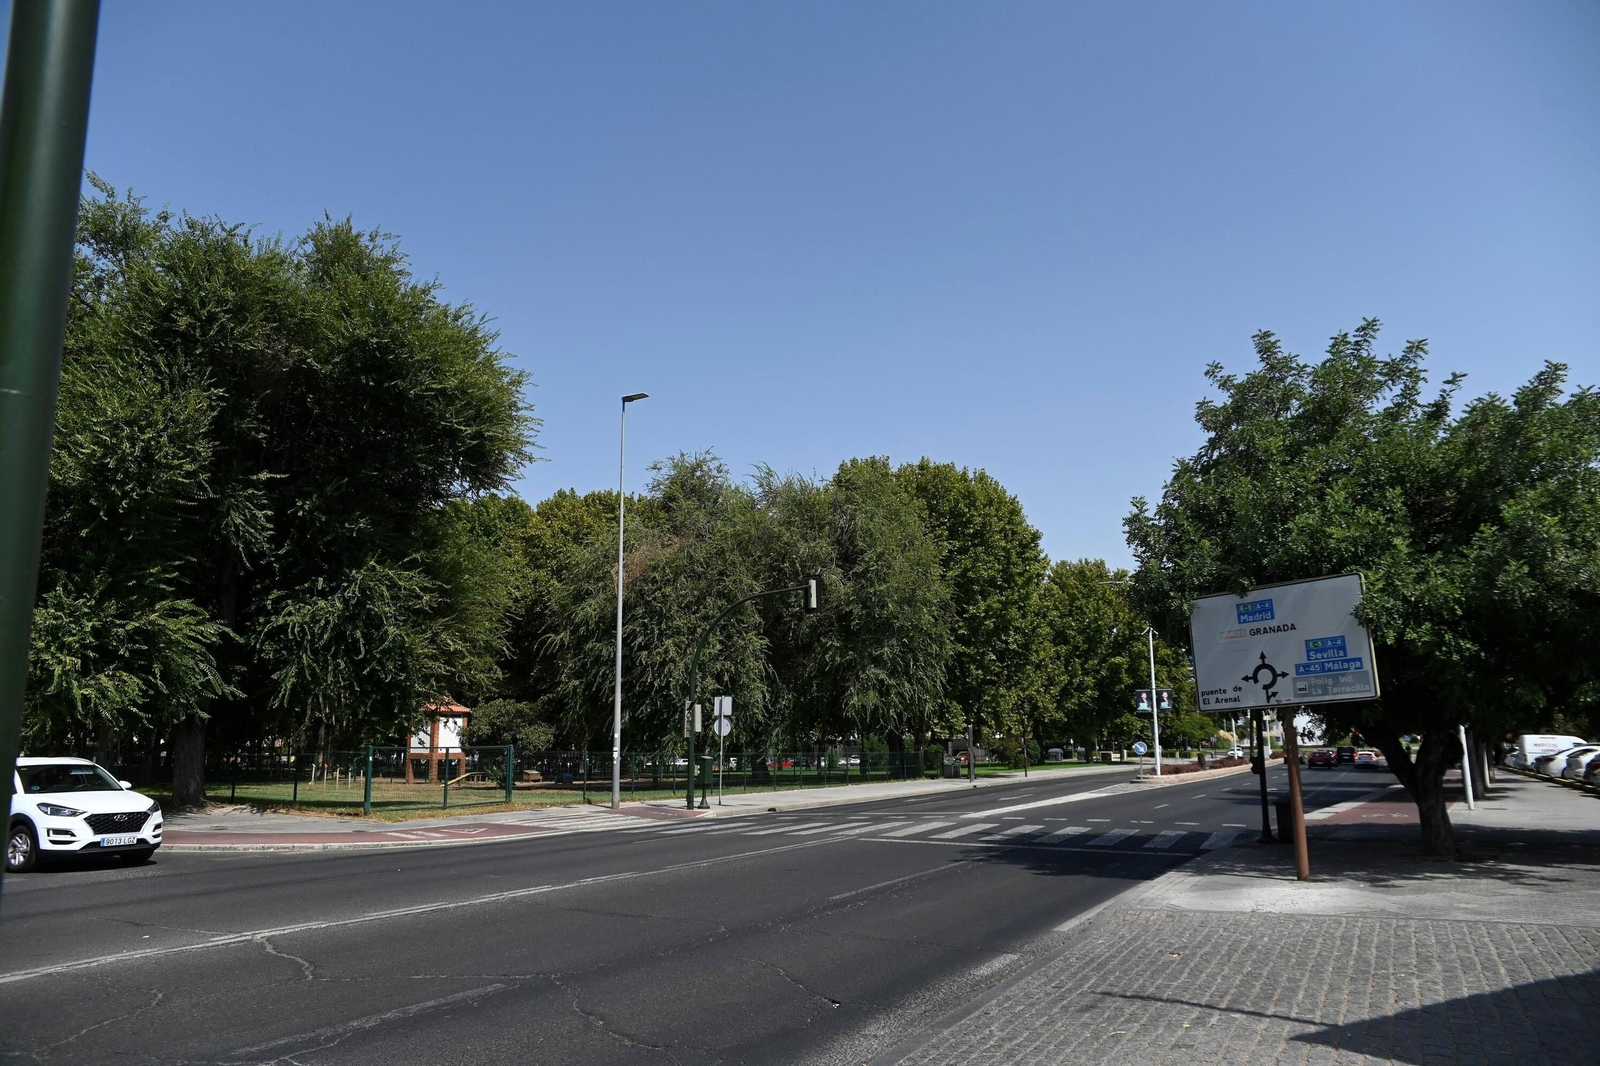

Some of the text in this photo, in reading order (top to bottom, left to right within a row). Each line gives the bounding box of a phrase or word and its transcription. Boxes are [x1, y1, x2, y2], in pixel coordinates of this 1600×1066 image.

[1240, 611, 1272, 623] Madrid
[1249, 623, 1297, 637] GRANADA
[1309, 649, 1345, 660] Sevilla
[1299, 660, 1361, 673] A-45 Málaga
[1201, 688, 1227, 698] puente
[1312, 684, 1370, 696] La Torrecilla
[1202, 696, 1241, 706] El Arenal
